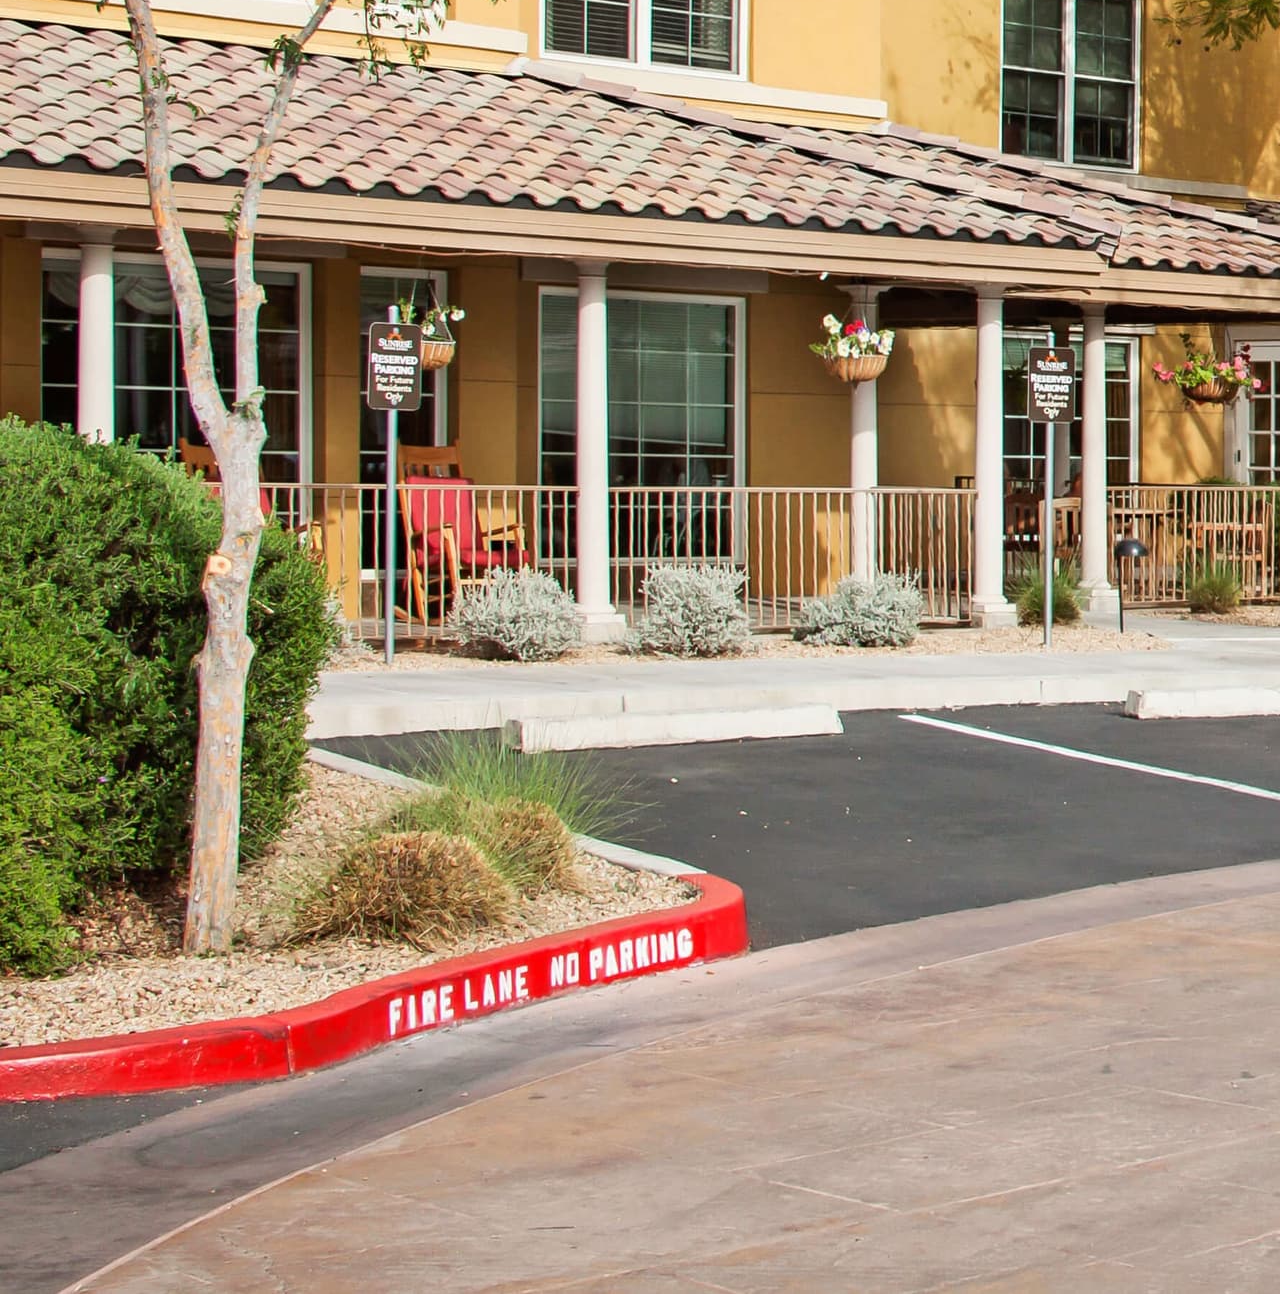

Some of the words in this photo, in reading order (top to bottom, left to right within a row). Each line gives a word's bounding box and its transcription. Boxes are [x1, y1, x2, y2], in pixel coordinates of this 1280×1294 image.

[371, 353, 418, 364] RESERVED
[374, 364, 414, 375] PARKING
[375, 376, 388, 384] For
[390, 376, 414, 385] Future
[1030, 373, 1072, 383] RESERVED
[376, 384, 412, 392] Residents
[1034, 383, 1069, 393] PARKING
[385, 393, 403, 402] Only
[1035, 392, 1046, 400] For
[1047, 393, 1069, 401] Future
[389, 985, 455, 1036] FIRE
[464, 965, 529, 1010] LANE
[550, 951, 580, 987] NO
[589, 928, 694, 981] PARKING
